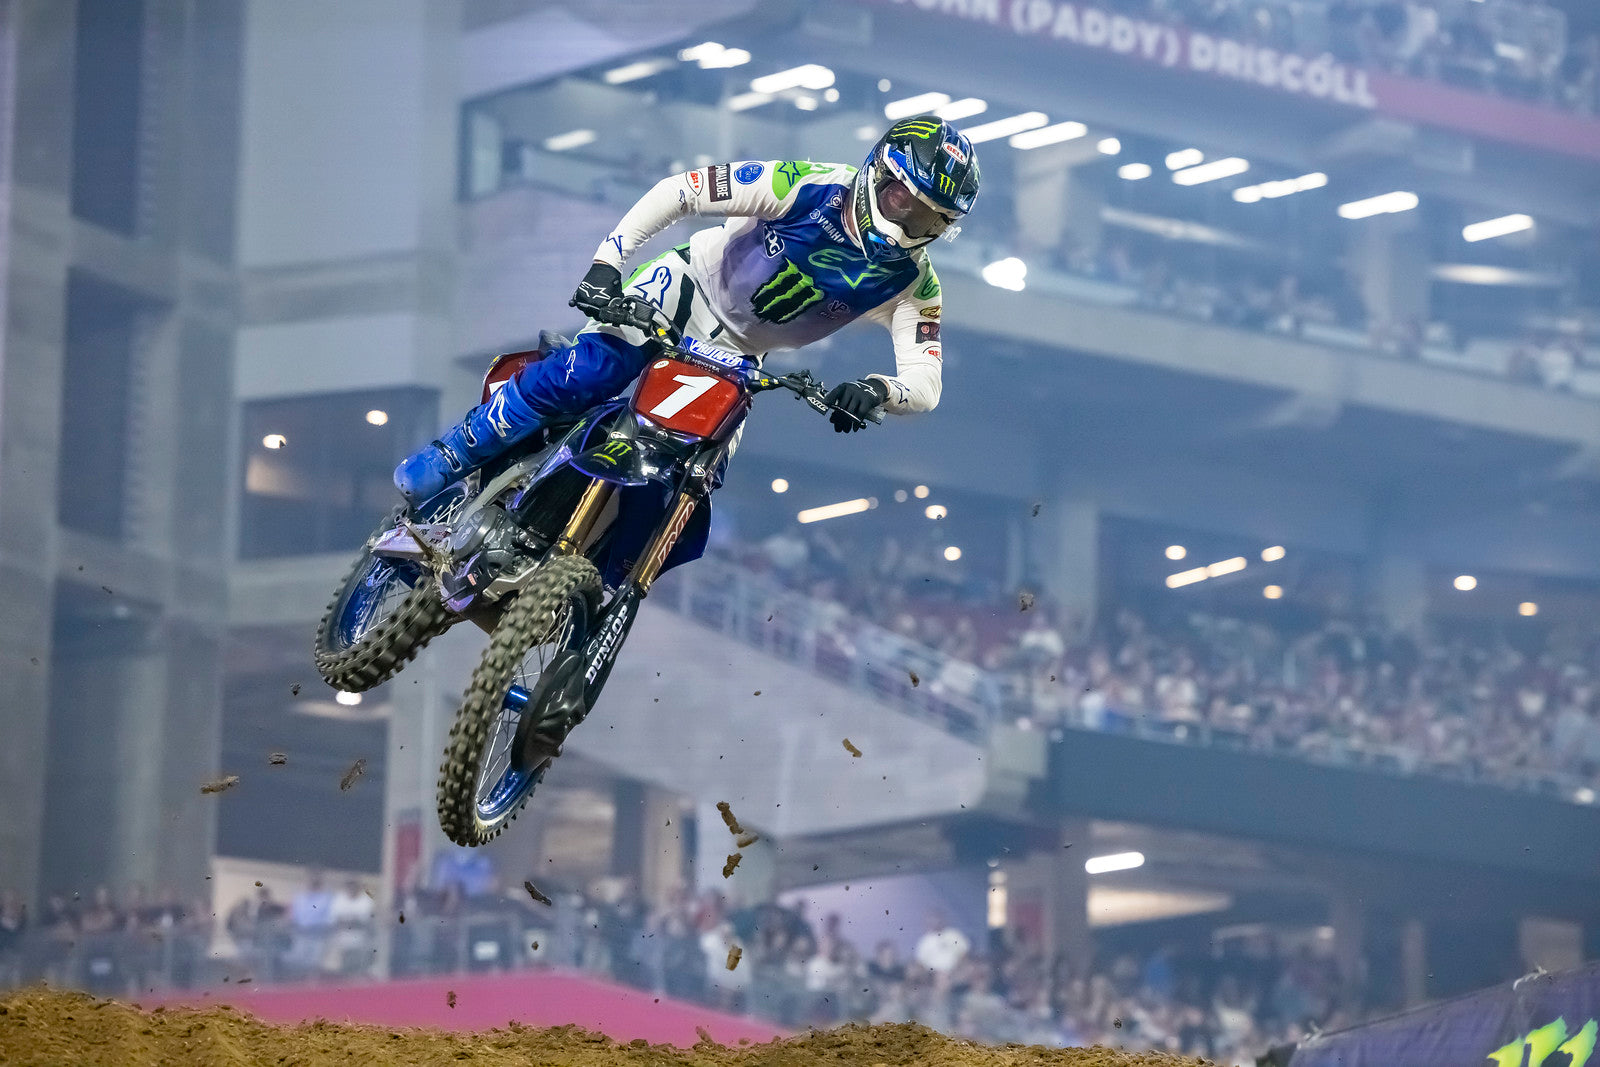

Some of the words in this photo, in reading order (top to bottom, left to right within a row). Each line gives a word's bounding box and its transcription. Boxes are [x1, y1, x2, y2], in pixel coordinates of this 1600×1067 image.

[1008, 0, 1179, 67] (PADDY)
[715, 164, 729, 198] AMALUBE
[817, 215, 845, 244] YAMAHA
[649, 374, 720, 420] 1
[585, 604, 628, 685] DUNLOP
